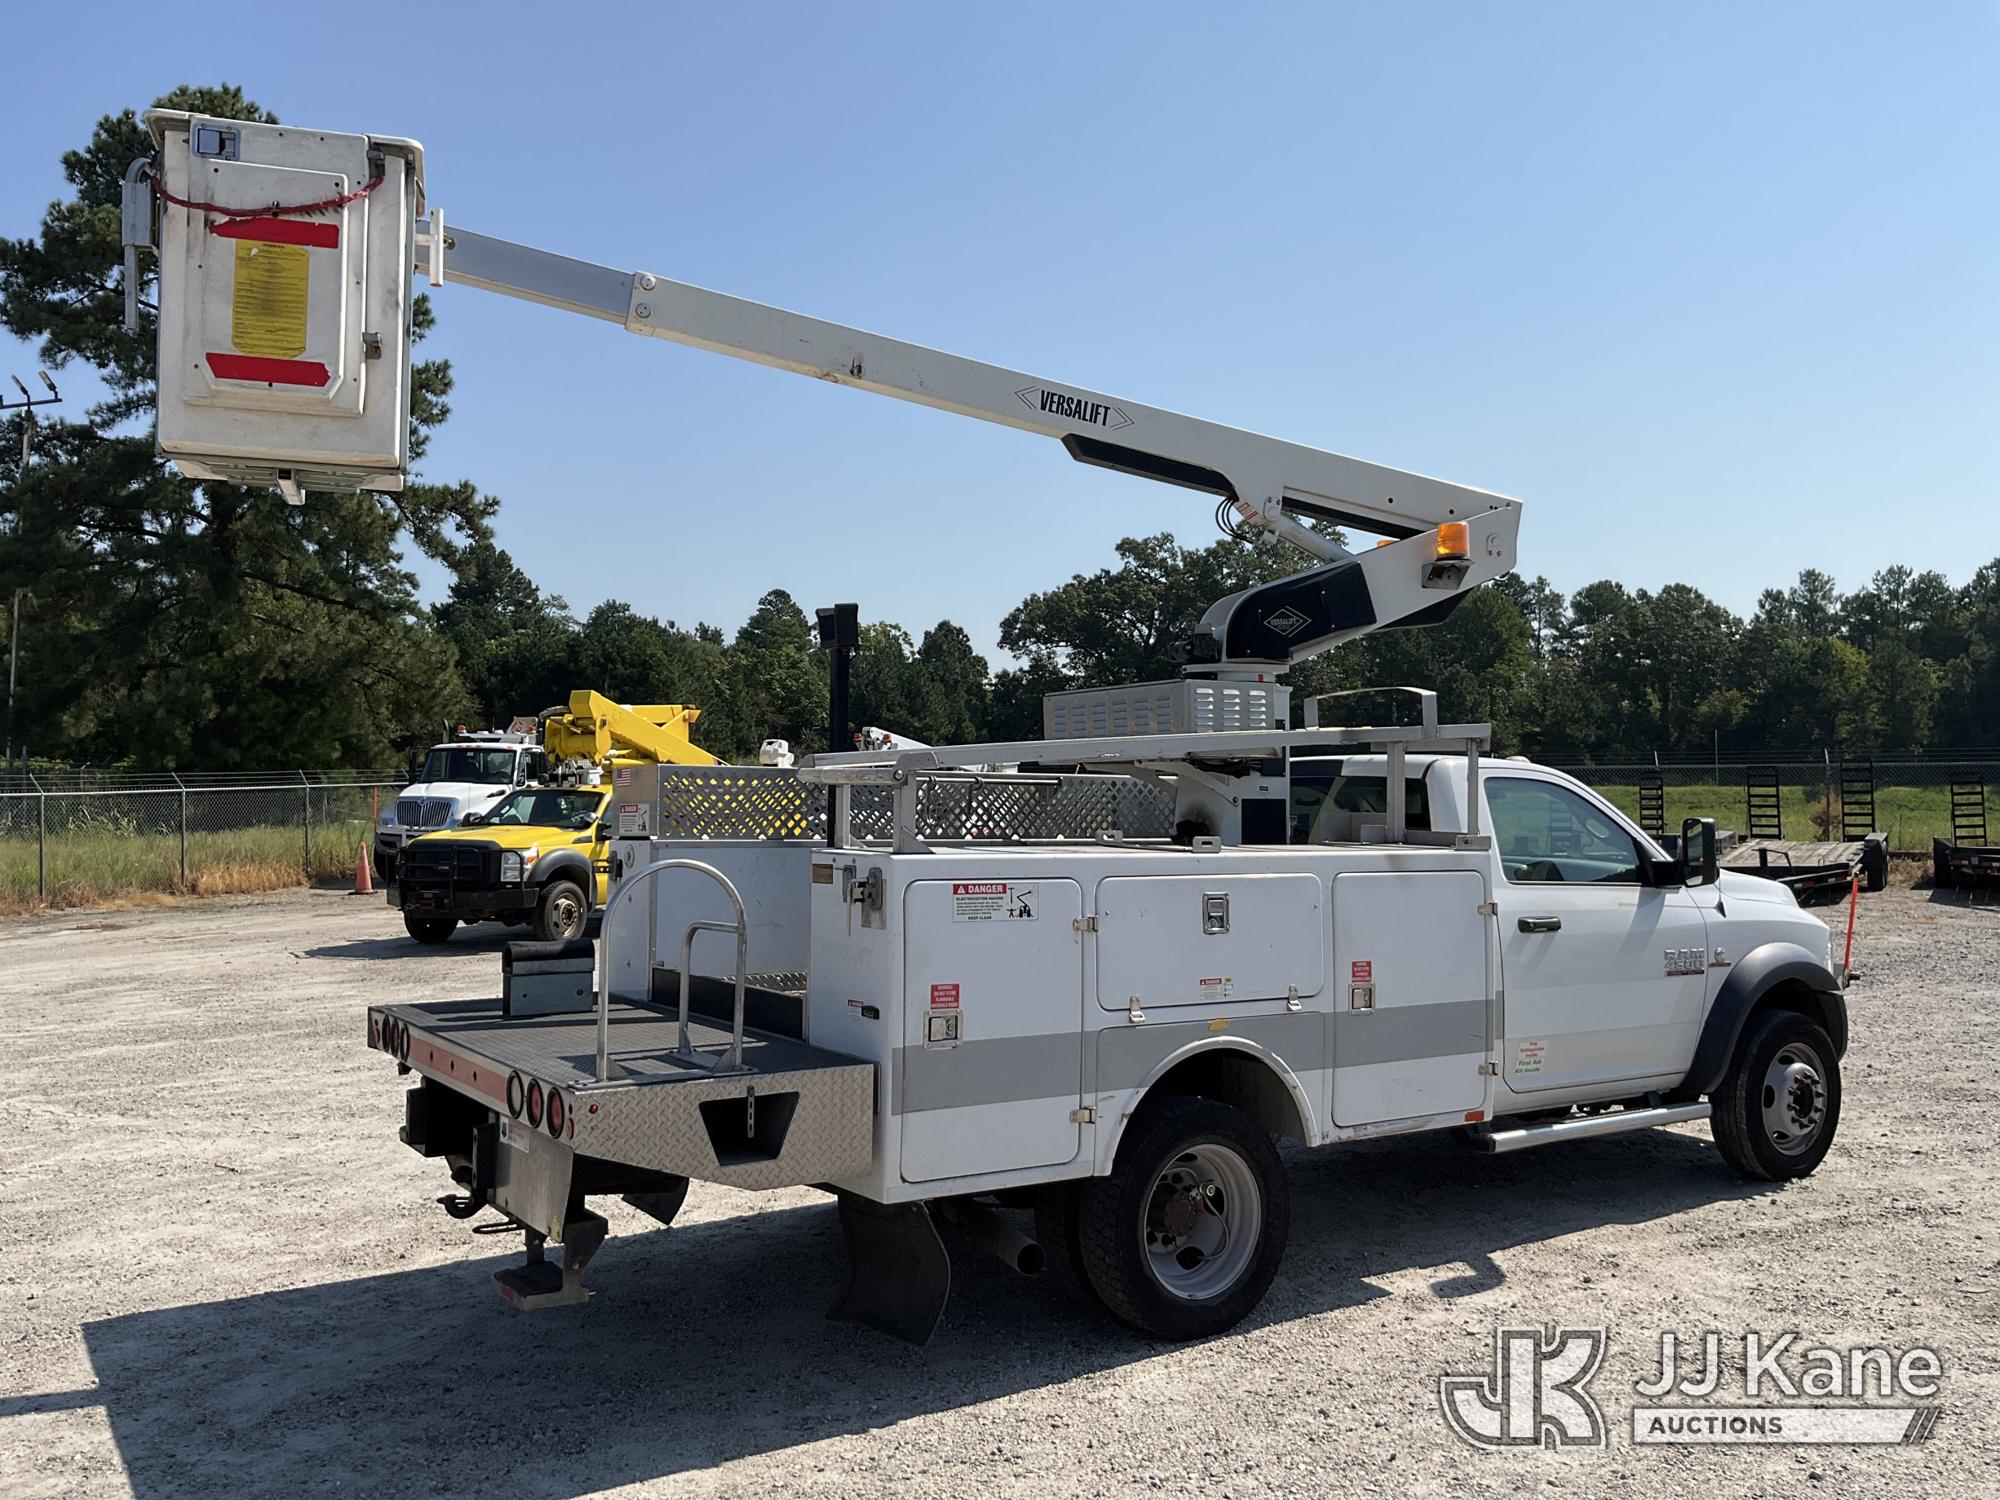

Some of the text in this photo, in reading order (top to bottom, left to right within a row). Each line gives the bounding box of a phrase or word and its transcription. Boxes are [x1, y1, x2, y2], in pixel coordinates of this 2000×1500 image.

[1040, 389, 1110, 426] VERSALIFT
[1270, 617, 1297, 626] VERSALIFT
[968, 884, 1003, 893] DANGER
[1664, 948, 1704, 960] RAM
